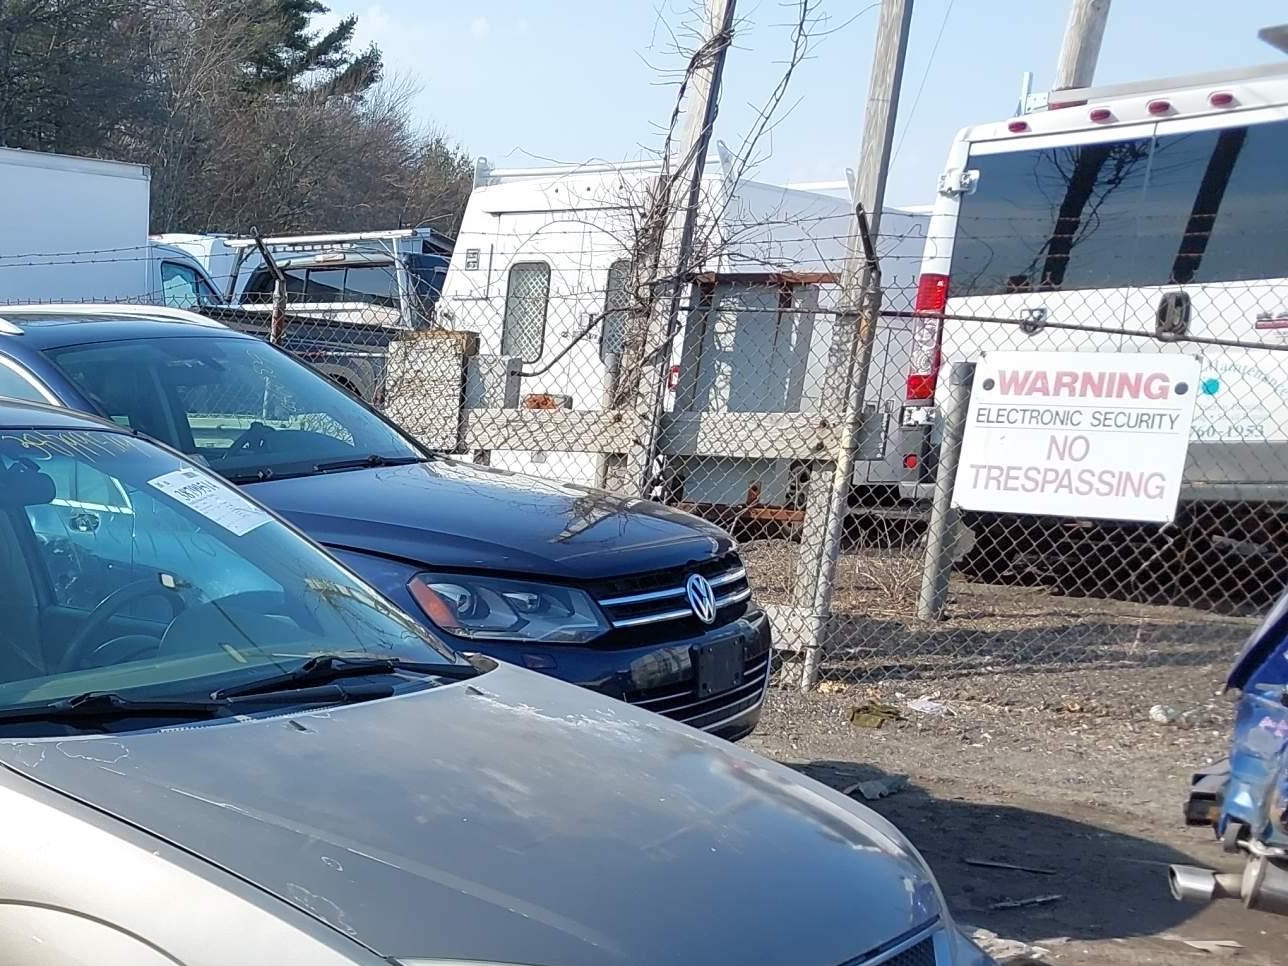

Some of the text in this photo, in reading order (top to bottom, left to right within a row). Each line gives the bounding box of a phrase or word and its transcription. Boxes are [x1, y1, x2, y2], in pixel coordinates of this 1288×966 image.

[998, 370, 1171, 400] WARNING
[975, 407, 1181, 430] ELECTRONIC SECURITY
[1046, 435, 1090, 462] NO
[969, 463, 1167, 500] TRESPASSING
